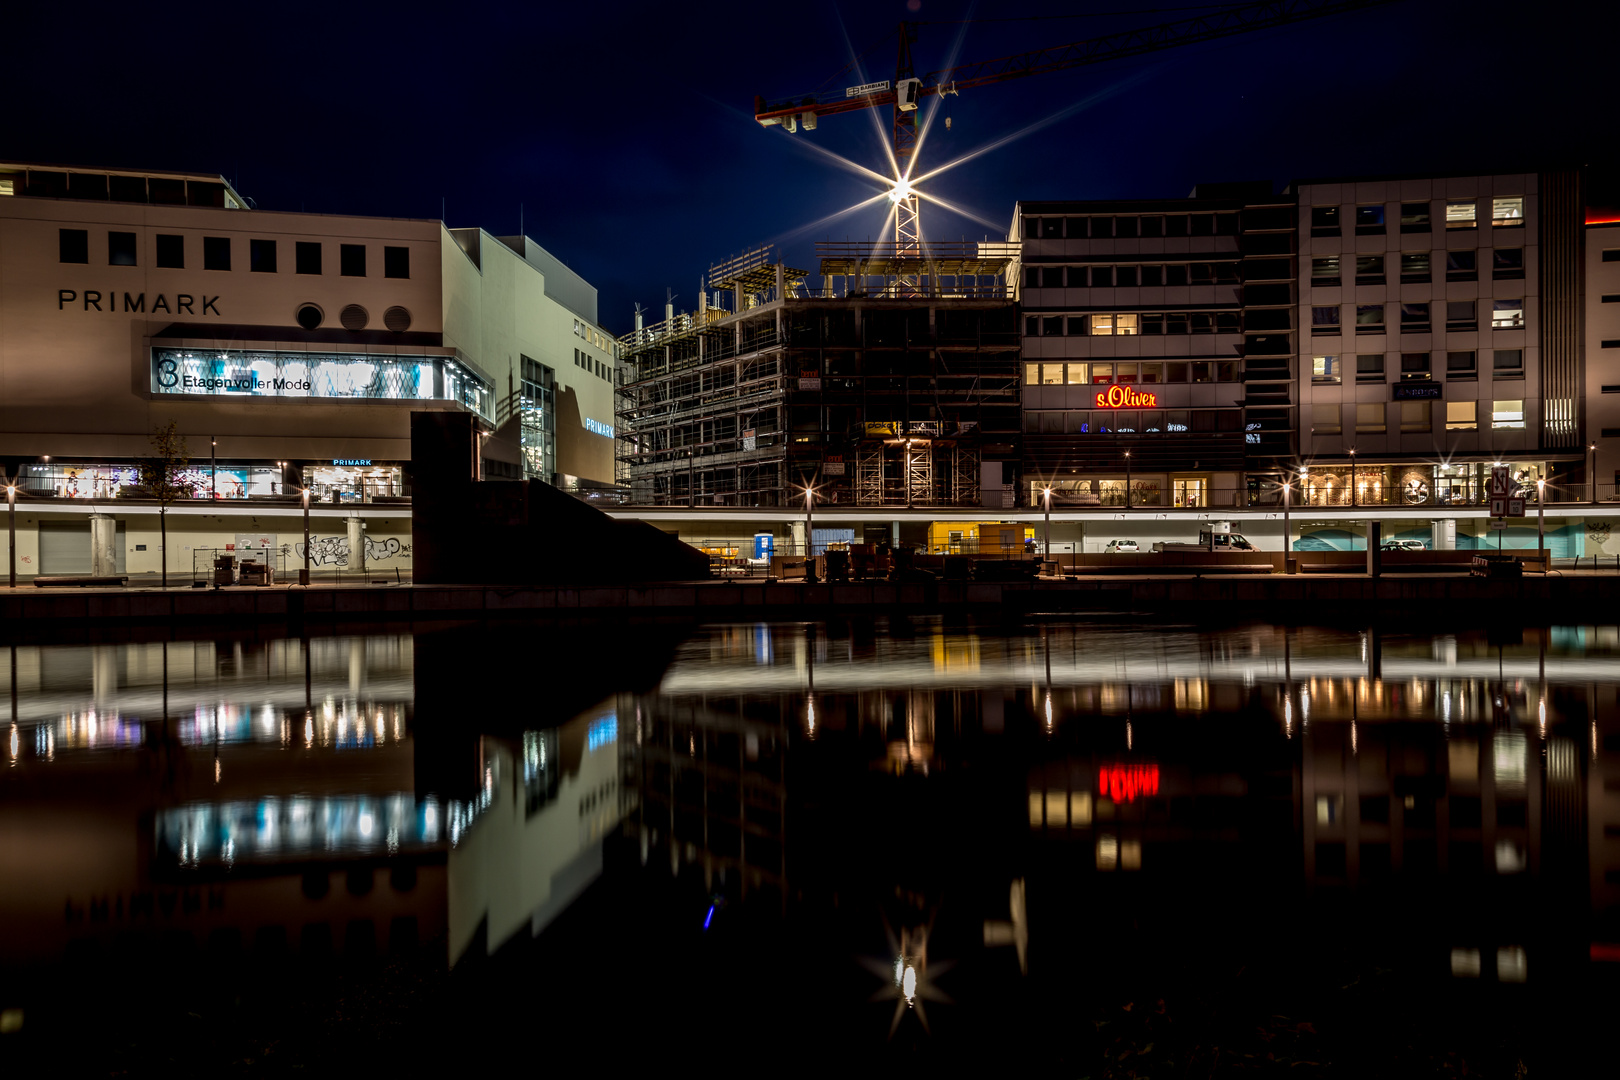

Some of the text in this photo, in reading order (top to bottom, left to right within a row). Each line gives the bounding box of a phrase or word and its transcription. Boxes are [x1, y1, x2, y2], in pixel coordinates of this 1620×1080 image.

[860, 82, 885, 91] BARBIAN
[59, 289, 220, 316] PRIMARK
[157, 359, 310, 391] 3 Etagen voller Mode
[1096, 384, 1156, 408] s.Oliver
[586, 417, 614, 439] PRIMARK
